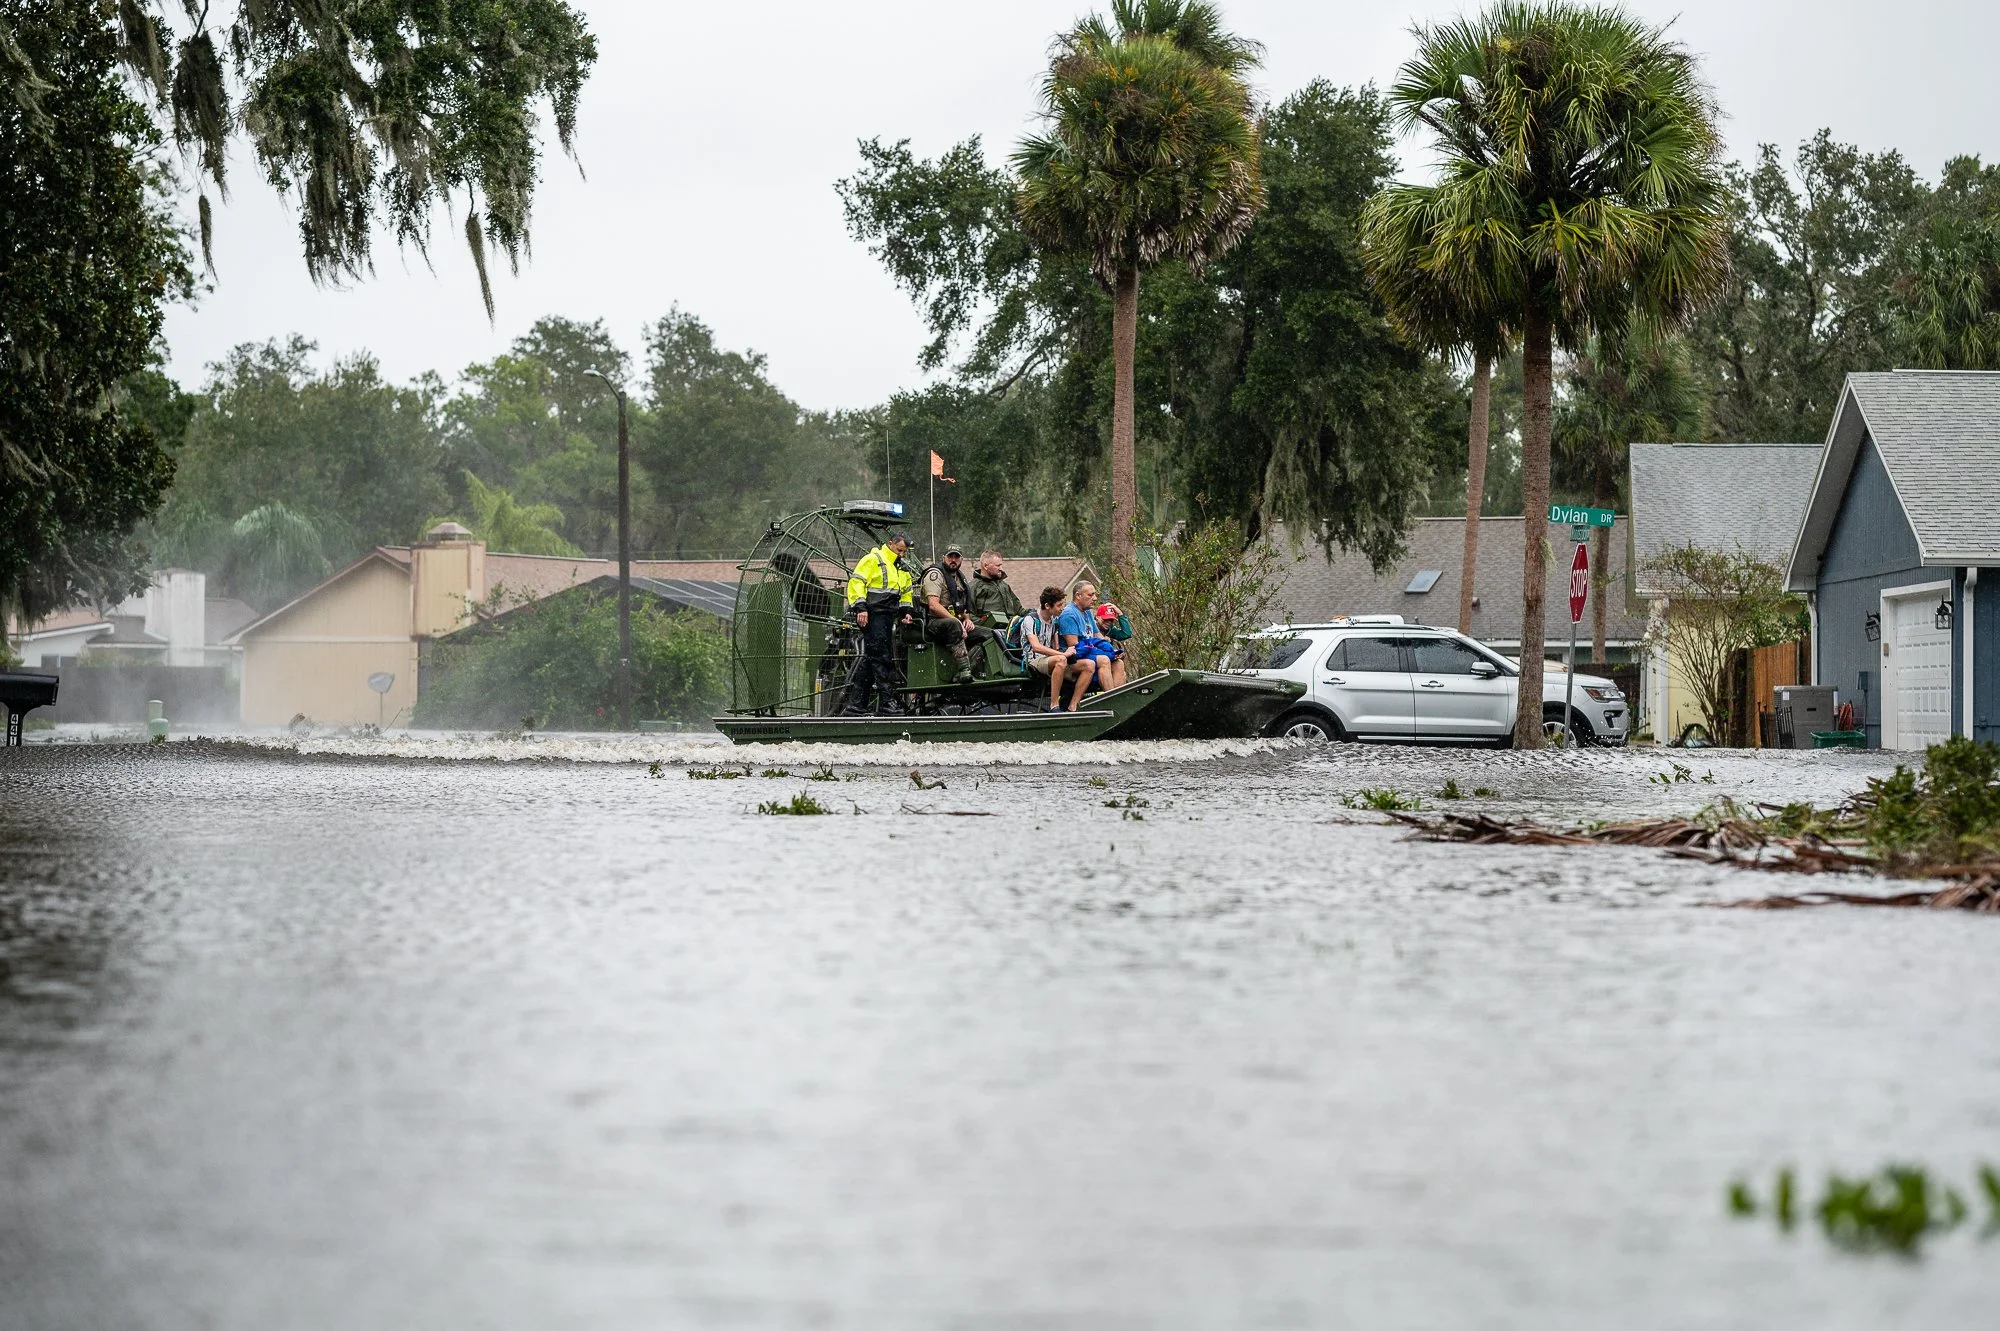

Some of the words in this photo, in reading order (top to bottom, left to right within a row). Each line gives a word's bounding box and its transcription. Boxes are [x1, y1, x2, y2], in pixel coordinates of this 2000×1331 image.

[1551, 506, 1588, 523] Dylan
[1600, 513, 1612, 523] DR
[1570, 568, 1588, 598] STOP
